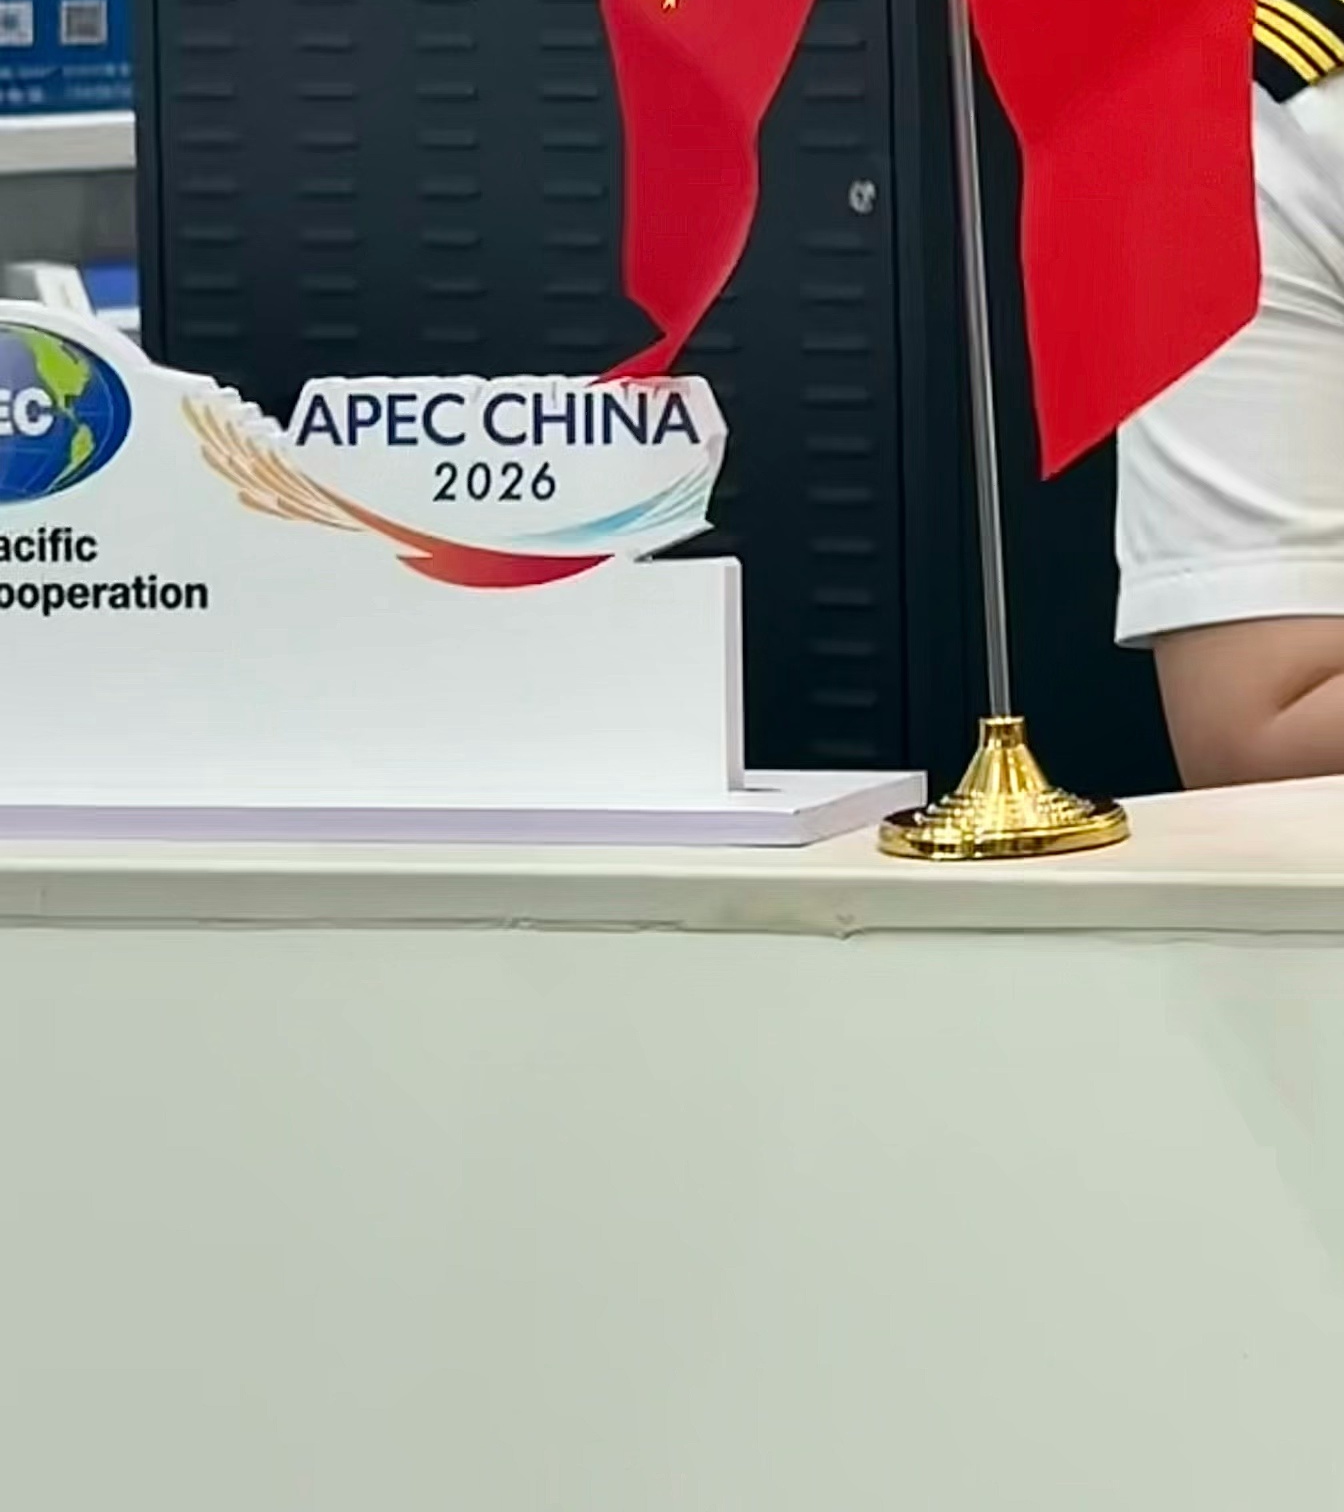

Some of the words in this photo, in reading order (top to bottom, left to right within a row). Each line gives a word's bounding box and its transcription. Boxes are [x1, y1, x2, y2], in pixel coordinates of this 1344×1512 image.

[296, 393, 466, 446] APEC
[483, 392, 701, 446] CHINA
[433, 461, 556, 502] 2026
